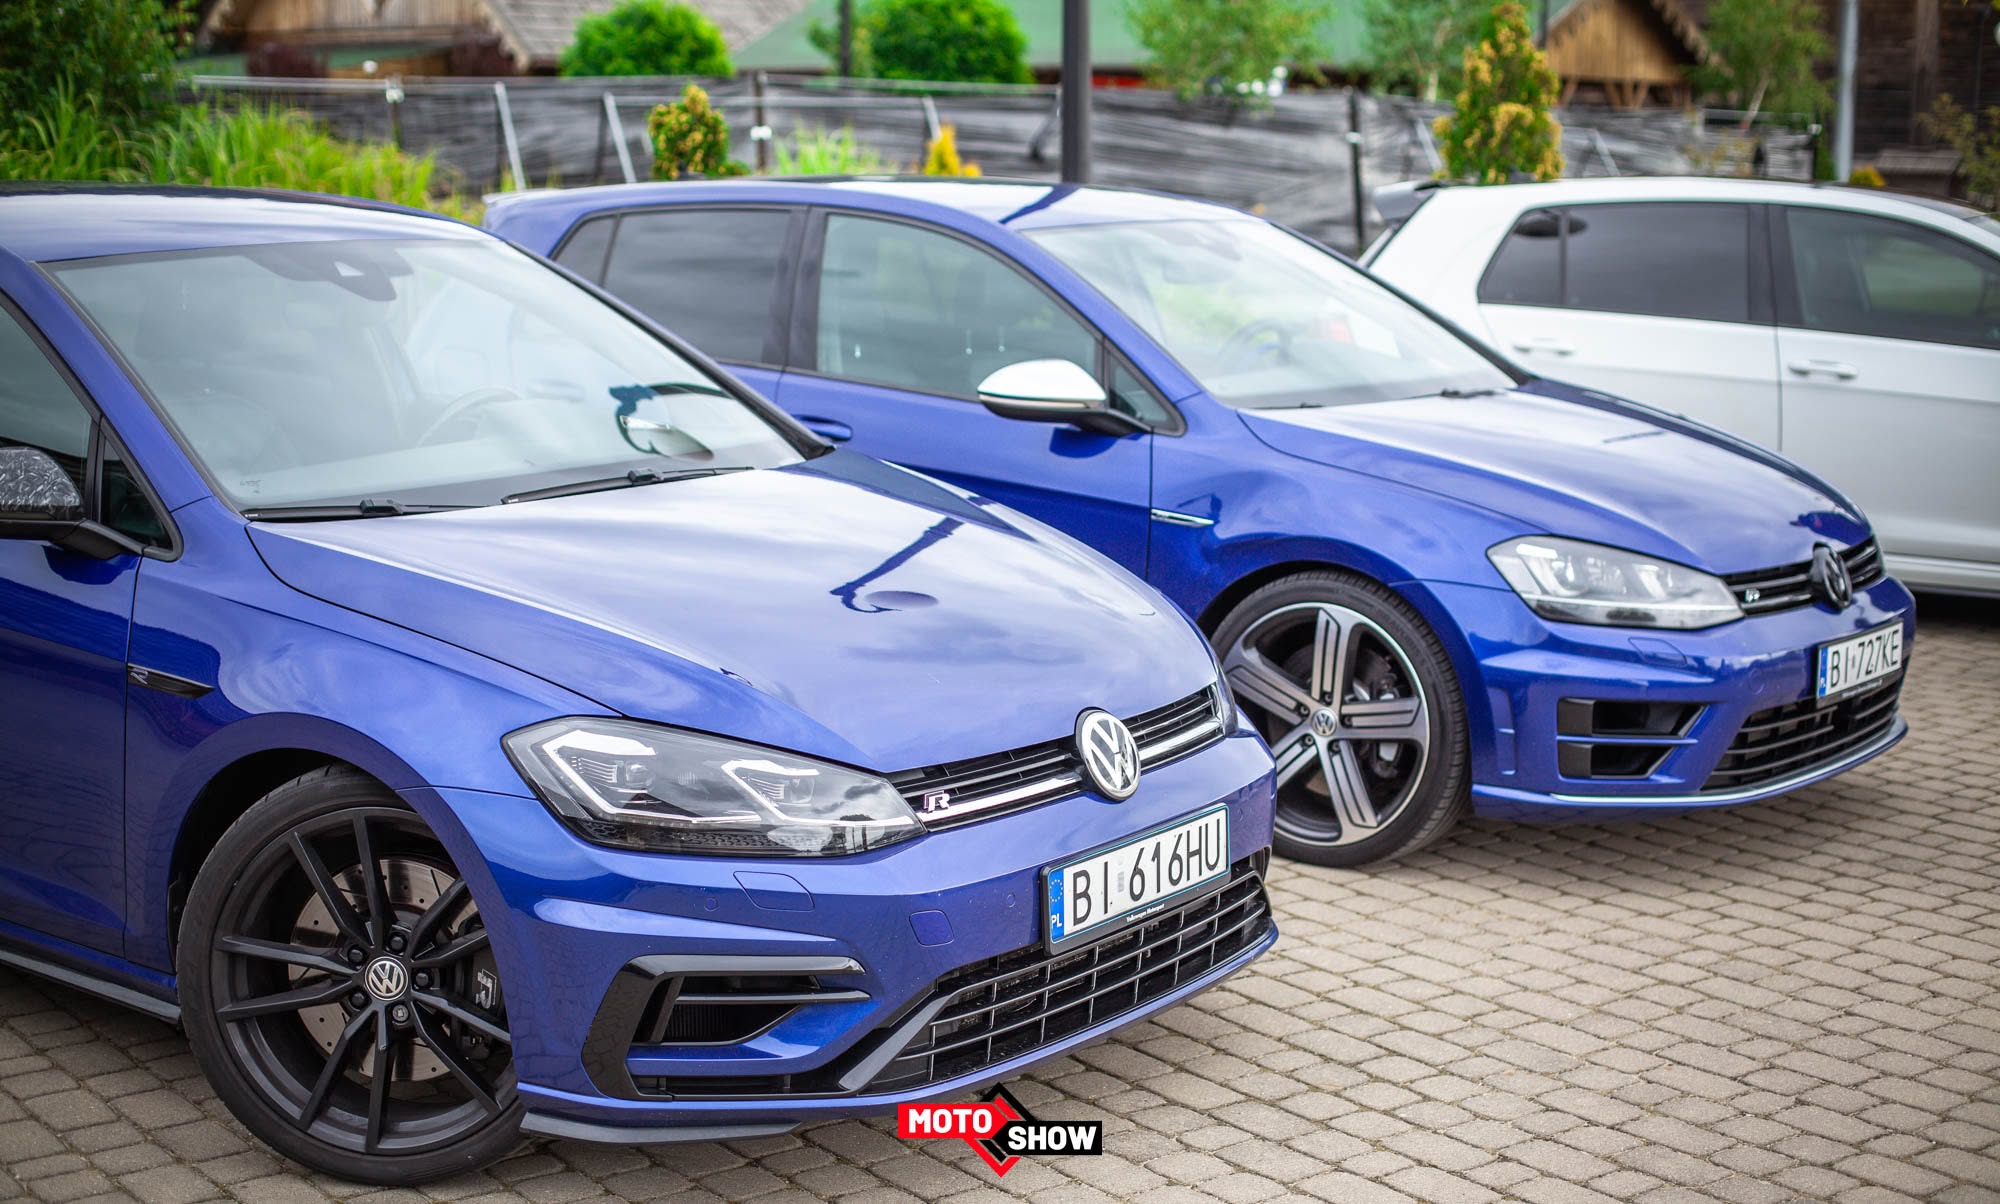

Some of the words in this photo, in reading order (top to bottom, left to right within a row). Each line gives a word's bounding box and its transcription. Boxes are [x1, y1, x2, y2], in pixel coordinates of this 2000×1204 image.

[1831, 646, 1849, 689] BI
[1857, 629, 1900, 680] 727KE
[924, 790, 950, 813] R
[1072, 861, 1109, 927] BI
[1129, 818, 1221, 902] 616HU
[1051, 912, 1063, 929] PL
